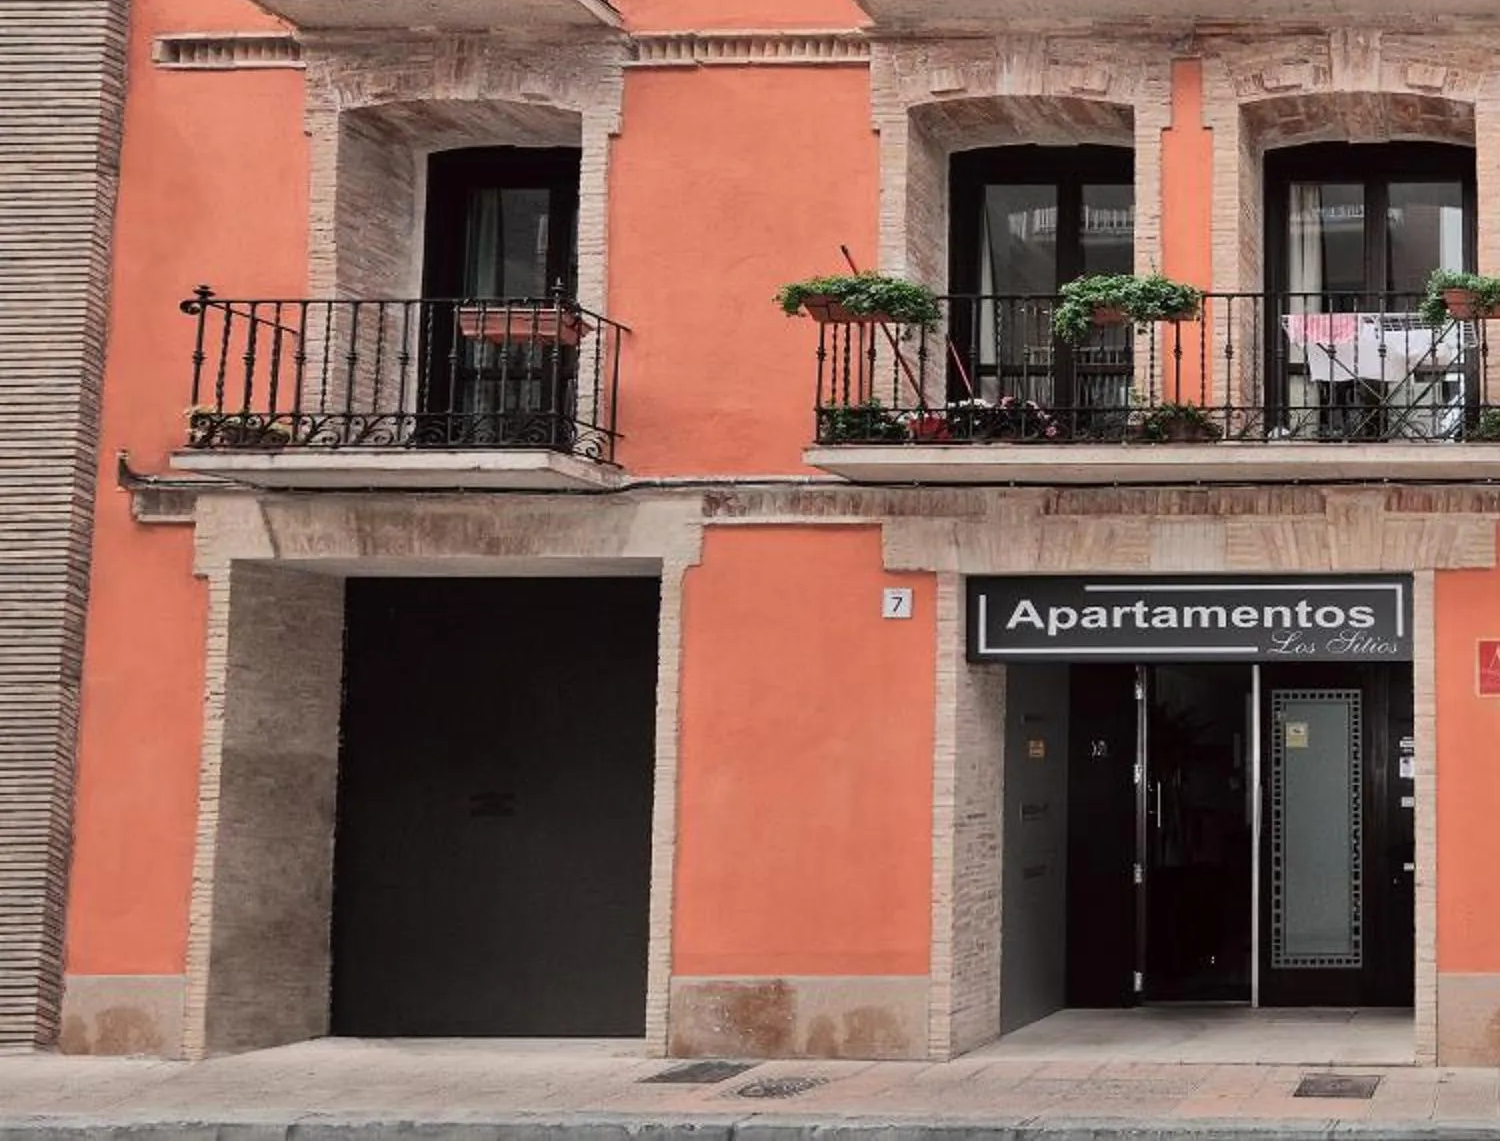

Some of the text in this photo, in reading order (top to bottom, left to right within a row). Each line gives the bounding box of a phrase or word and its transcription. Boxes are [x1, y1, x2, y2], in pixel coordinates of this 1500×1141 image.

[891, 596, 903, 612] 7
[1006, 599, 1376, 636] Apartamentos
[1267, 630, 1398, 654] Los Sitios
